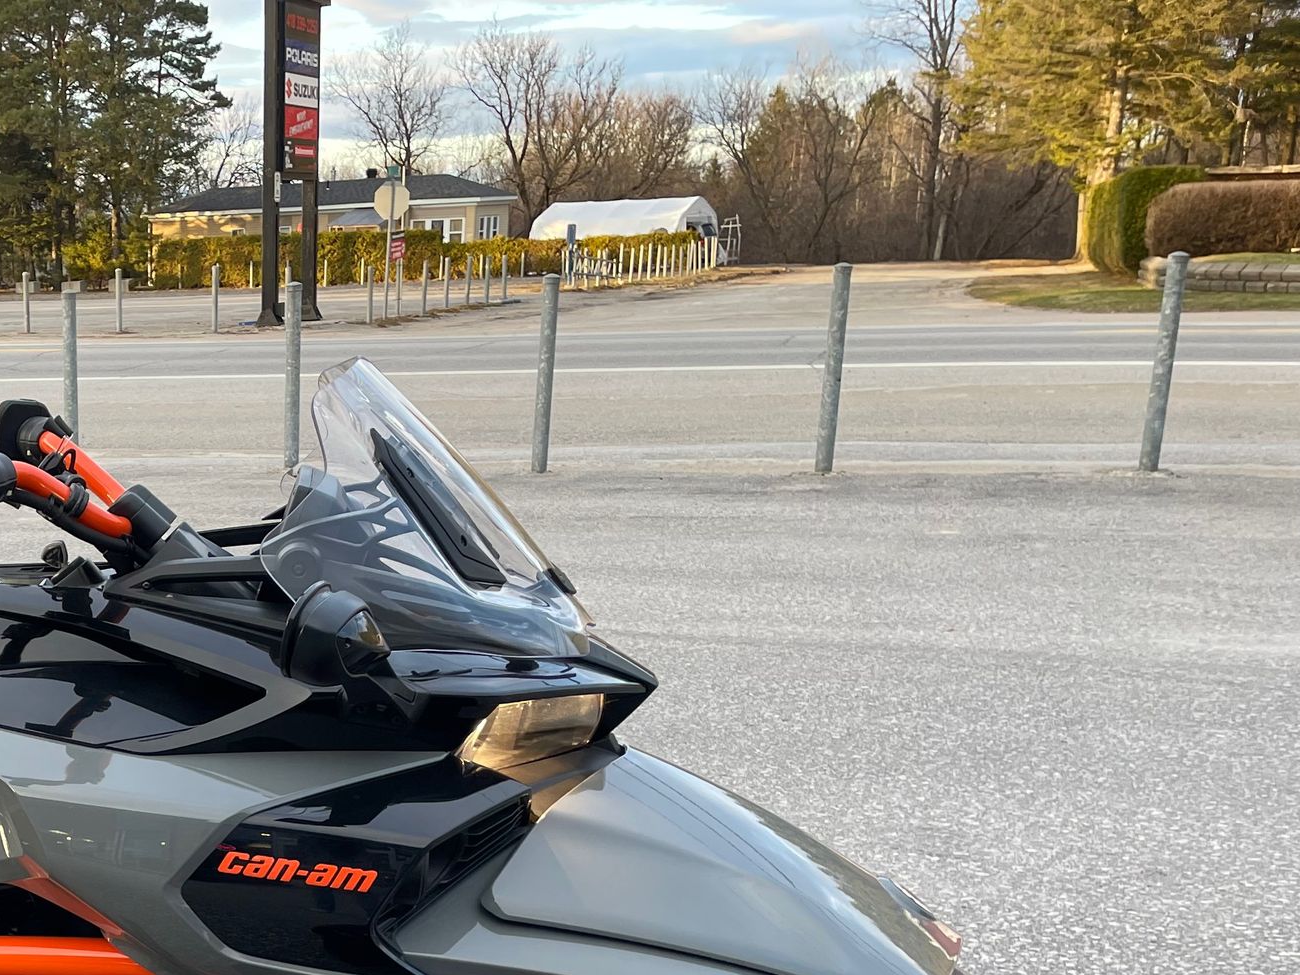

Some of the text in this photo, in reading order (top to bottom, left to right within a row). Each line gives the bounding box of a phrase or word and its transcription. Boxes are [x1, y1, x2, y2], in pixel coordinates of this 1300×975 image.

[286, 47, 318, 67] POLARIS
[293, 82, 318, 100] SUZUKI
[217, 851, 378, 893] can-am
